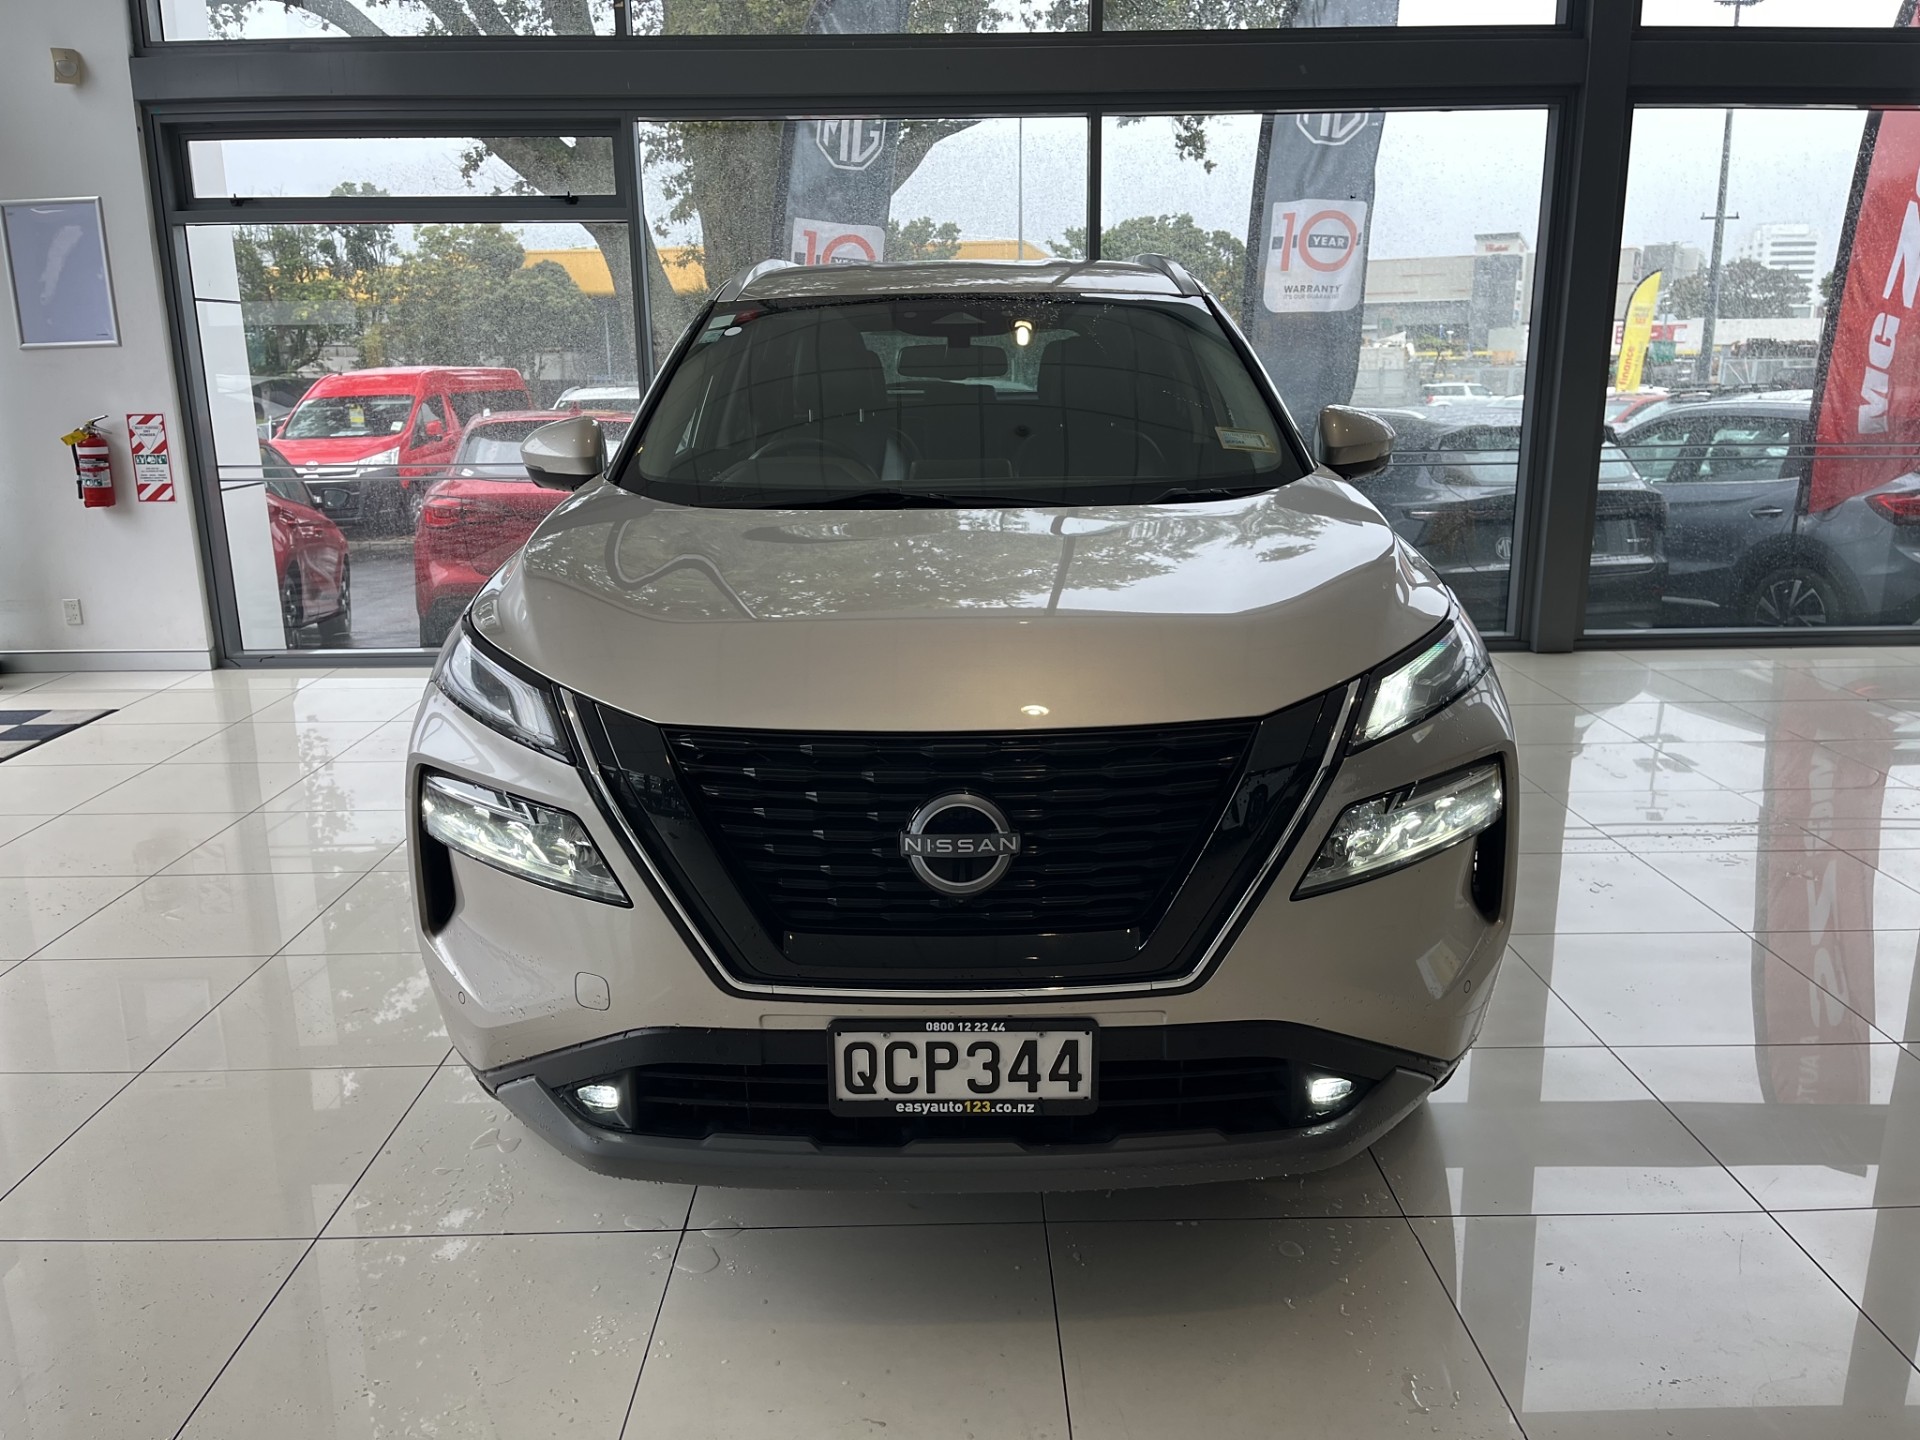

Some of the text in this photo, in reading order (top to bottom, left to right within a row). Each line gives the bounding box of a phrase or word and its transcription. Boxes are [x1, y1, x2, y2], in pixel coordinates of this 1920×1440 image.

[1280, 210, 1358, 272] 10
[1313, 235, 1345, 247] YEAR
[1284, 284, 1342, 294] WARRANTY
[1858, 312, 1900, 435] MG
[905, 837, 1016, 853] NISSAN
[926, 1021, 1006, 1032] 0800 12 22 44
[843, 1040, 1083, 1095] QCP344
[895, 1101, 1035, 1115] easyauto123.co.nz
